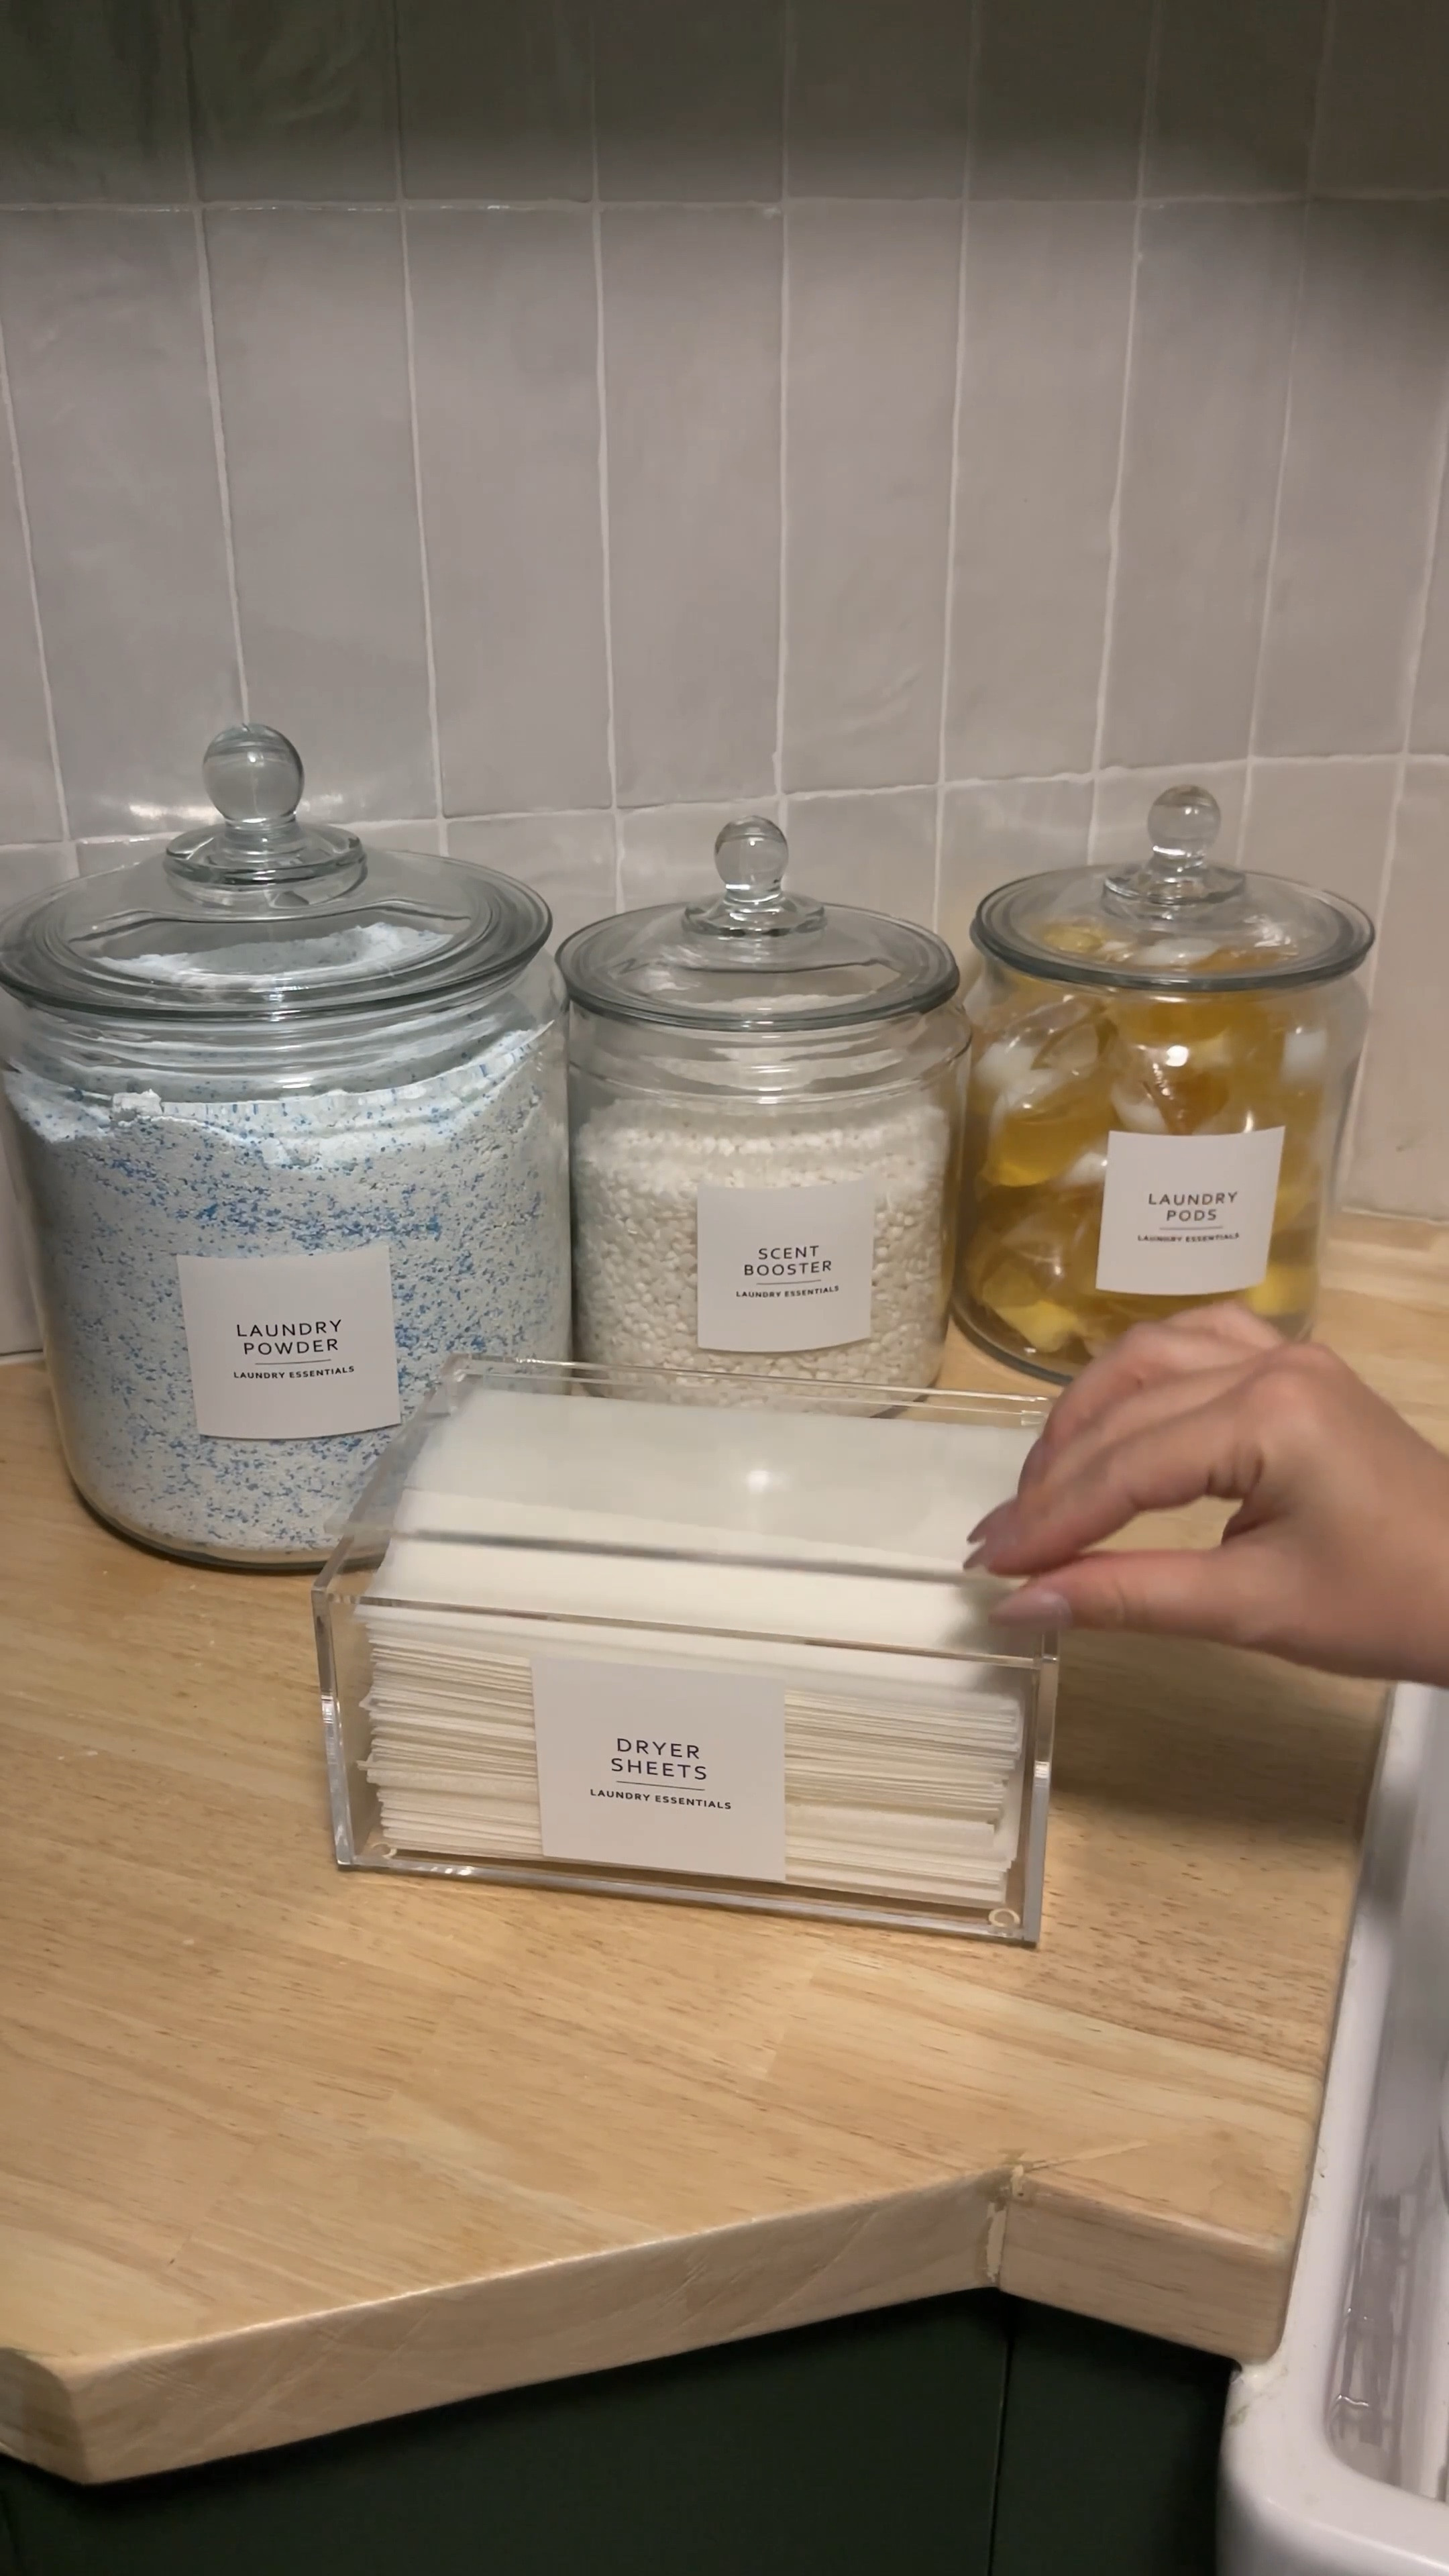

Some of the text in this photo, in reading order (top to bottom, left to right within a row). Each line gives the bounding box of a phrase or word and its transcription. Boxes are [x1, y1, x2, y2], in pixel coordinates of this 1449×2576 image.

[1148, 1191, 1238, 1205] LAUNDRY
[1166, 1210, 1217, 1222] PODS
[758, 1245, 819, 1260] SCENT
[744, 1260, 832, 1276] BOOSTER
[784, 1285, 839, 1297] ESSENTIALS
[236, 1319, 341, 1336] LAUNDRY
[244, 1338, 338, 1354] POWDER
[233, 1366, 354, 1379] LAUNDRY ESSENTIALS
[616, 1738, 700, 1759] DRYER
[611, 1758, 706, 1780] SHEETS
[590, 1788, 732, 1809] LAUNDRY ESSENTIALS
